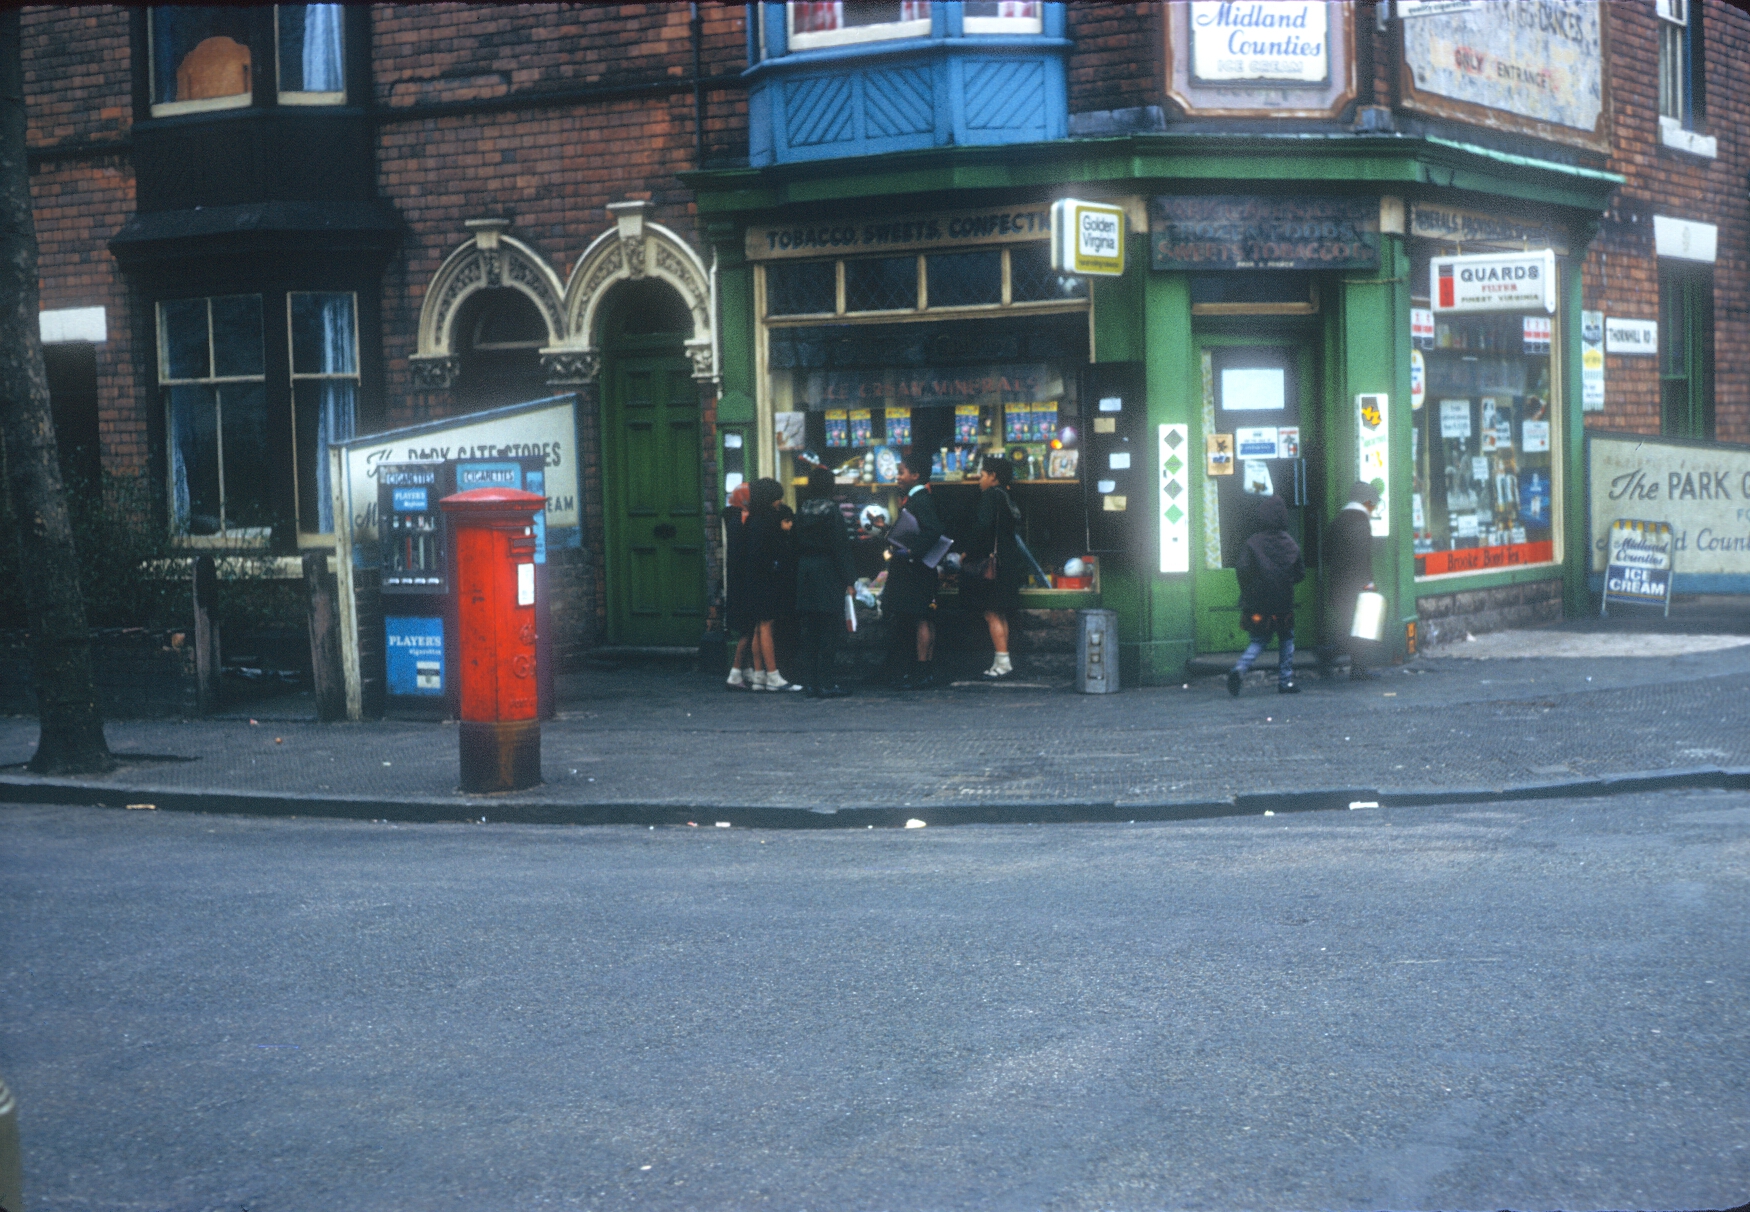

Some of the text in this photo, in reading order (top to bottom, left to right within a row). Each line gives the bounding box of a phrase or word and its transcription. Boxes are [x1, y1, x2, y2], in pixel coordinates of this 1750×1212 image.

[1196, 1, 1308, 28] Midland
[1228, 29, 1321, 57] Counties
[1083, 215, 1115, 233] Golden
[1083, 232, 1115, 253] Virginia
[463, 470, 515, 483] CIGARETTES
[1608, 468, 1659, 501] The
[1668, 471, 1732, 500] PARK
[1613, 537, 1669, 555] Midland
[1624, 567, 1652, 581] ICE
[1609, 578, 1665, 596] CREAM
